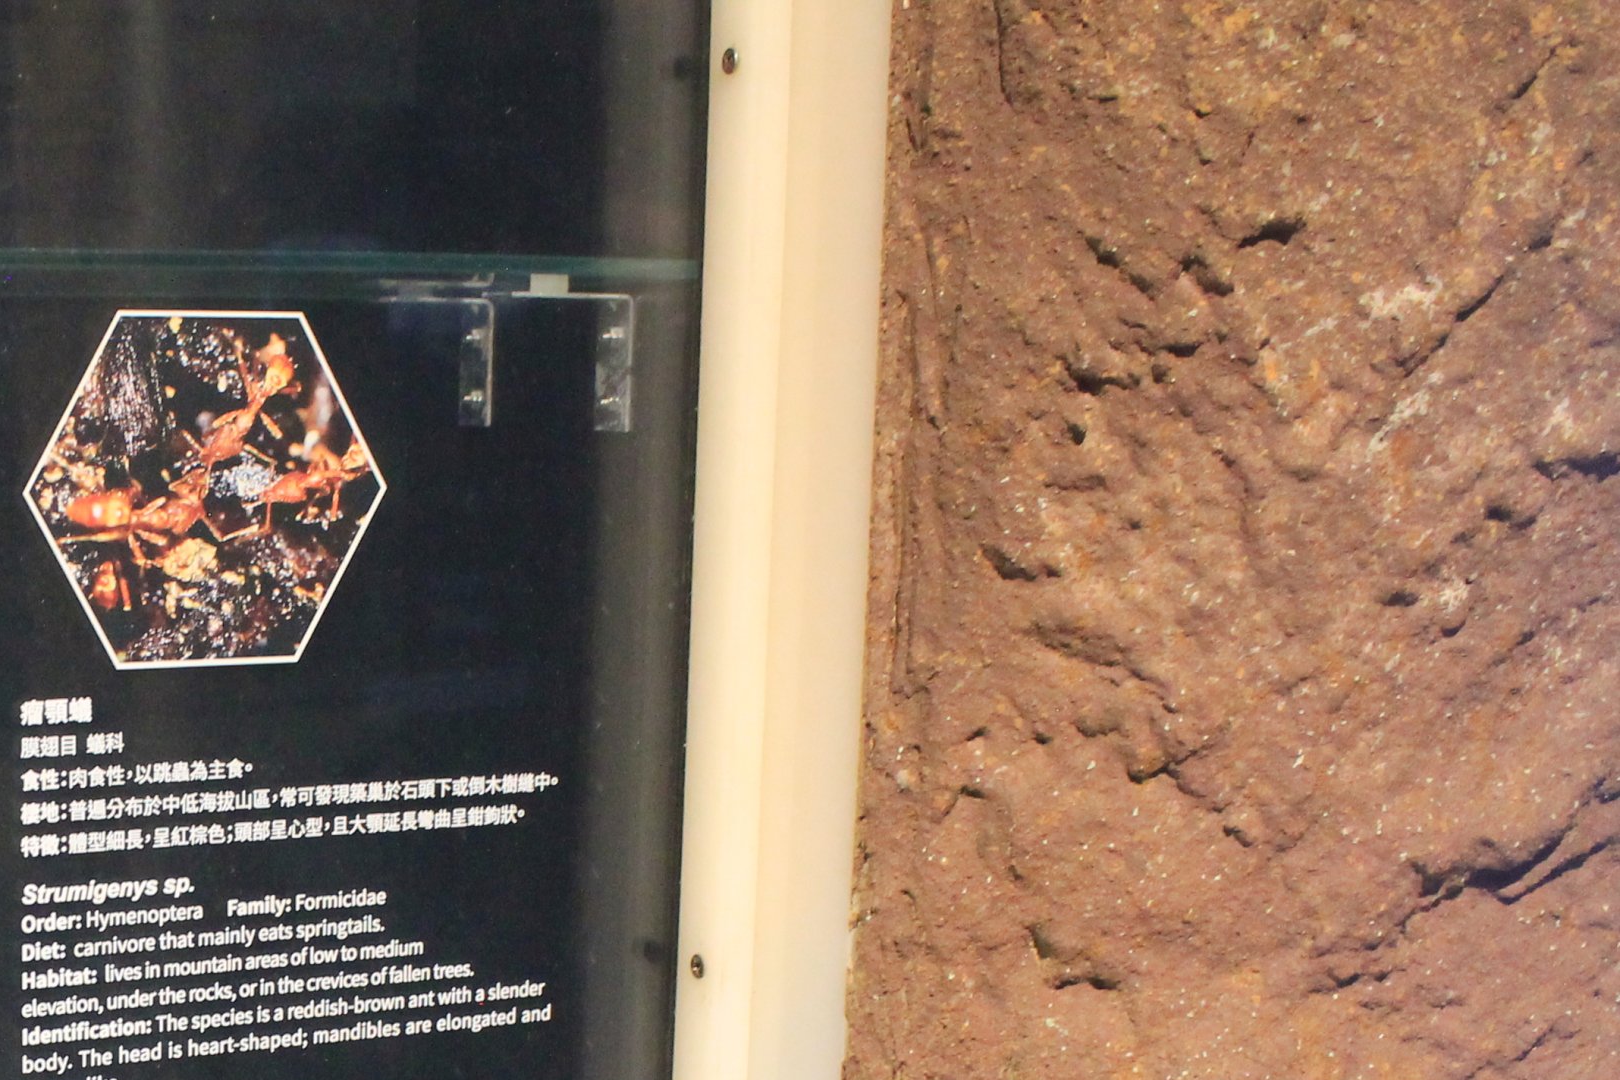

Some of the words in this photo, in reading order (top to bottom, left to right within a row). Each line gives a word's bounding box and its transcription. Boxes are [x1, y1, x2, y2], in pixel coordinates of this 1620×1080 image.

[86, 732, 125, 754] 蟻科
[21, 879, 158, 905] Strumigenys
[163, 877, 194, 898] sp.
[21, 912, 82, 933] Order:
[86, 905, 203, 932] Hymenoptera
[227, 895, 291, 917] Family:
[296, 888, 386, 911] Formicidae
[22, 941, 66, 962] Diet:
[74, 936, 156, 957] carnivore
[159, 931, 195, 950] that
[198, 925, 256, 947] mainly
[258, 924, 293, 941] eats
[296, 915, 385, 942] springtails.
[22, 967, 97, 990] Habitat:
[105, 964, 142, 982] lives
[145, 961, 160, 979] in
[164, 954, 242, 977] mountain
[245, 953, 288, 970] areas
[290, 946, 308, 966] of
[310, 946, 339, 964] low
[340, 945, 357, 961] to
[360, 939, 423, 960] medium
[22, 995, 104, 1018] elevation,
[107, 989, 157, 1010] under
[158, 986, 186, 1005] the
[189, 982, 237, 1002] rocks,
[239, 983, 258, 997] or
[260, 978, 275, 996] in
[277, 976, 304, 994] the
[306, 971, 369, 991] crevices
[371, 966, 388, 985] of
[389, 964, 430, 983] fallen
[433, 964, 474, 980] trees.
[22, 1018, 152, 1046] Identification:
[155, 1013, 188, 1032] The
[191, 1008, 253, 1030] species
[257, 1005, 270, 1023] is
[273, 1007, 283, 1021] a
[288, 996, 405, 1020] reddish-brown
[408, 991, 435, 1008] ant
[437, 986, 471, 1005] with
[475, 988, 485, 1002] a
[488, 980, 545, 1000] slender
[22, 1052, 72, 1074] body.
[78, 1048, 113, 1067] The
[119, 1042, 162, 1064] head
[168, 1041, 182, 1058] is
[188, 1028, 308, 1057] heart-shaped;
[313, 1020, 400, 1044] mandibles
[405, 1020, 432, 1035] are
[436, 1007, 516, 1032] elongated
[521, 1004, 551, 1023] and
